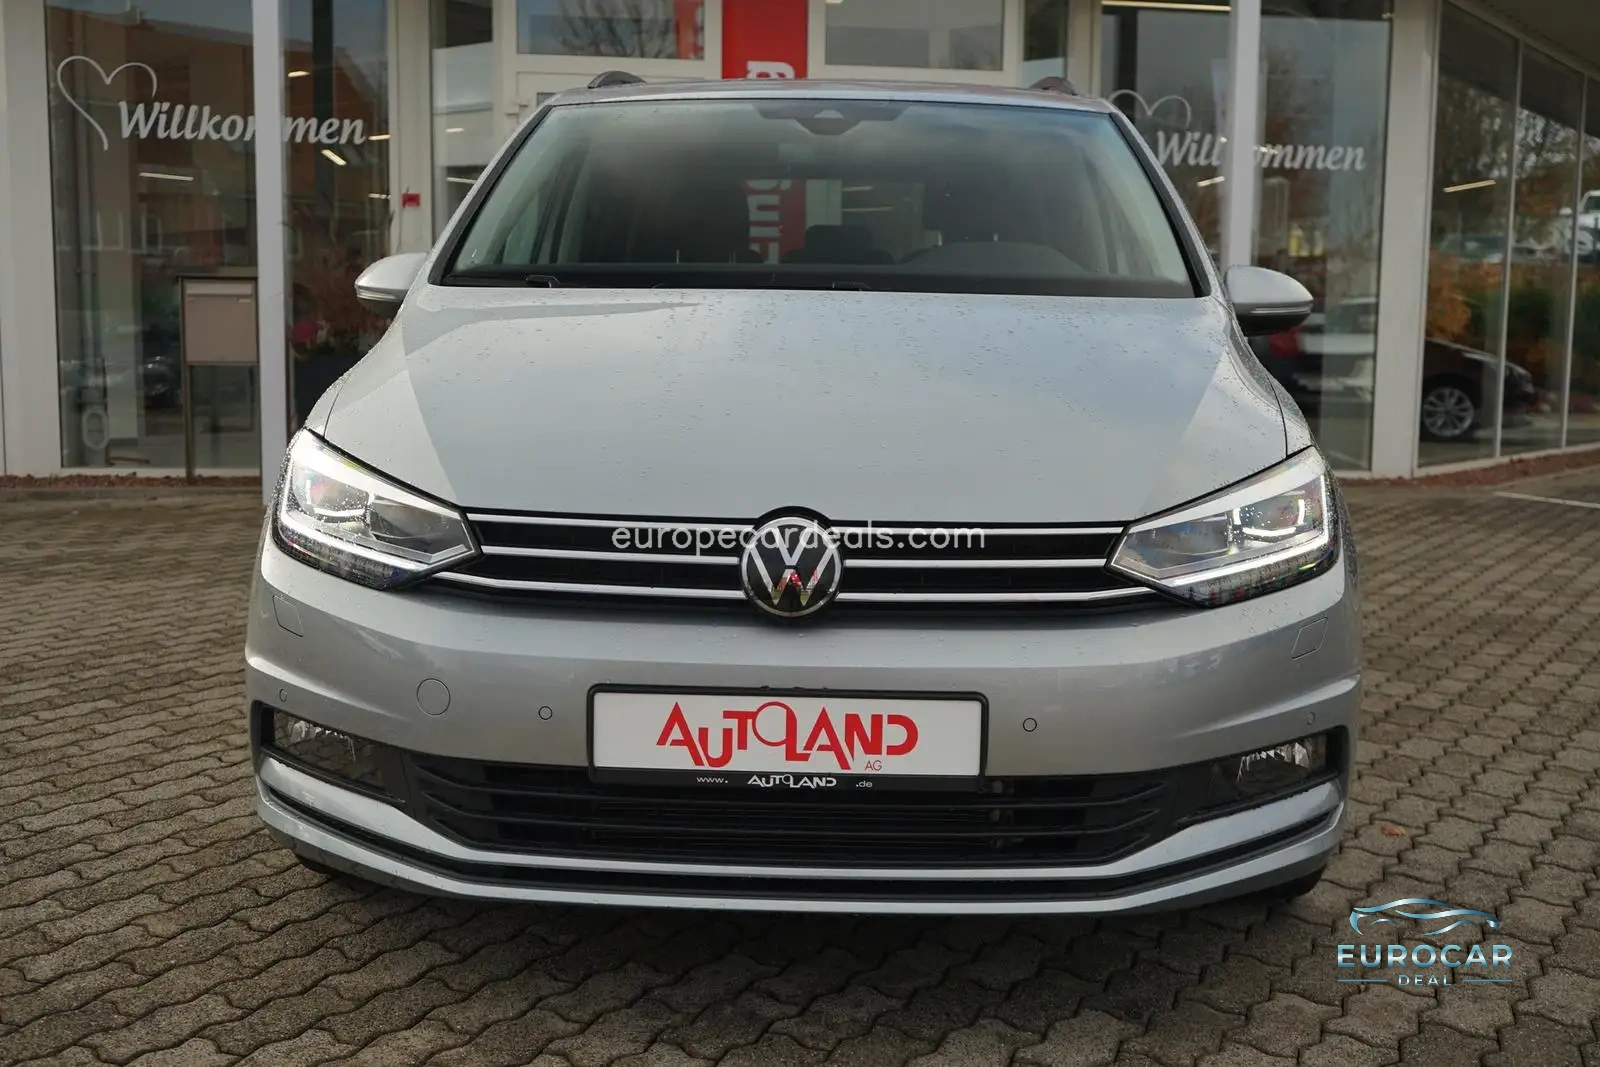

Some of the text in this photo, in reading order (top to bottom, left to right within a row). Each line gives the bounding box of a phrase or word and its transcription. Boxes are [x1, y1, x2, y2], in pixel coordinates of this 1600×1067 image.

[1156, 129, 1367, 172] Willmmen
[864, 759, 882, 772] AG
[696, 775, 729, 784] www.
